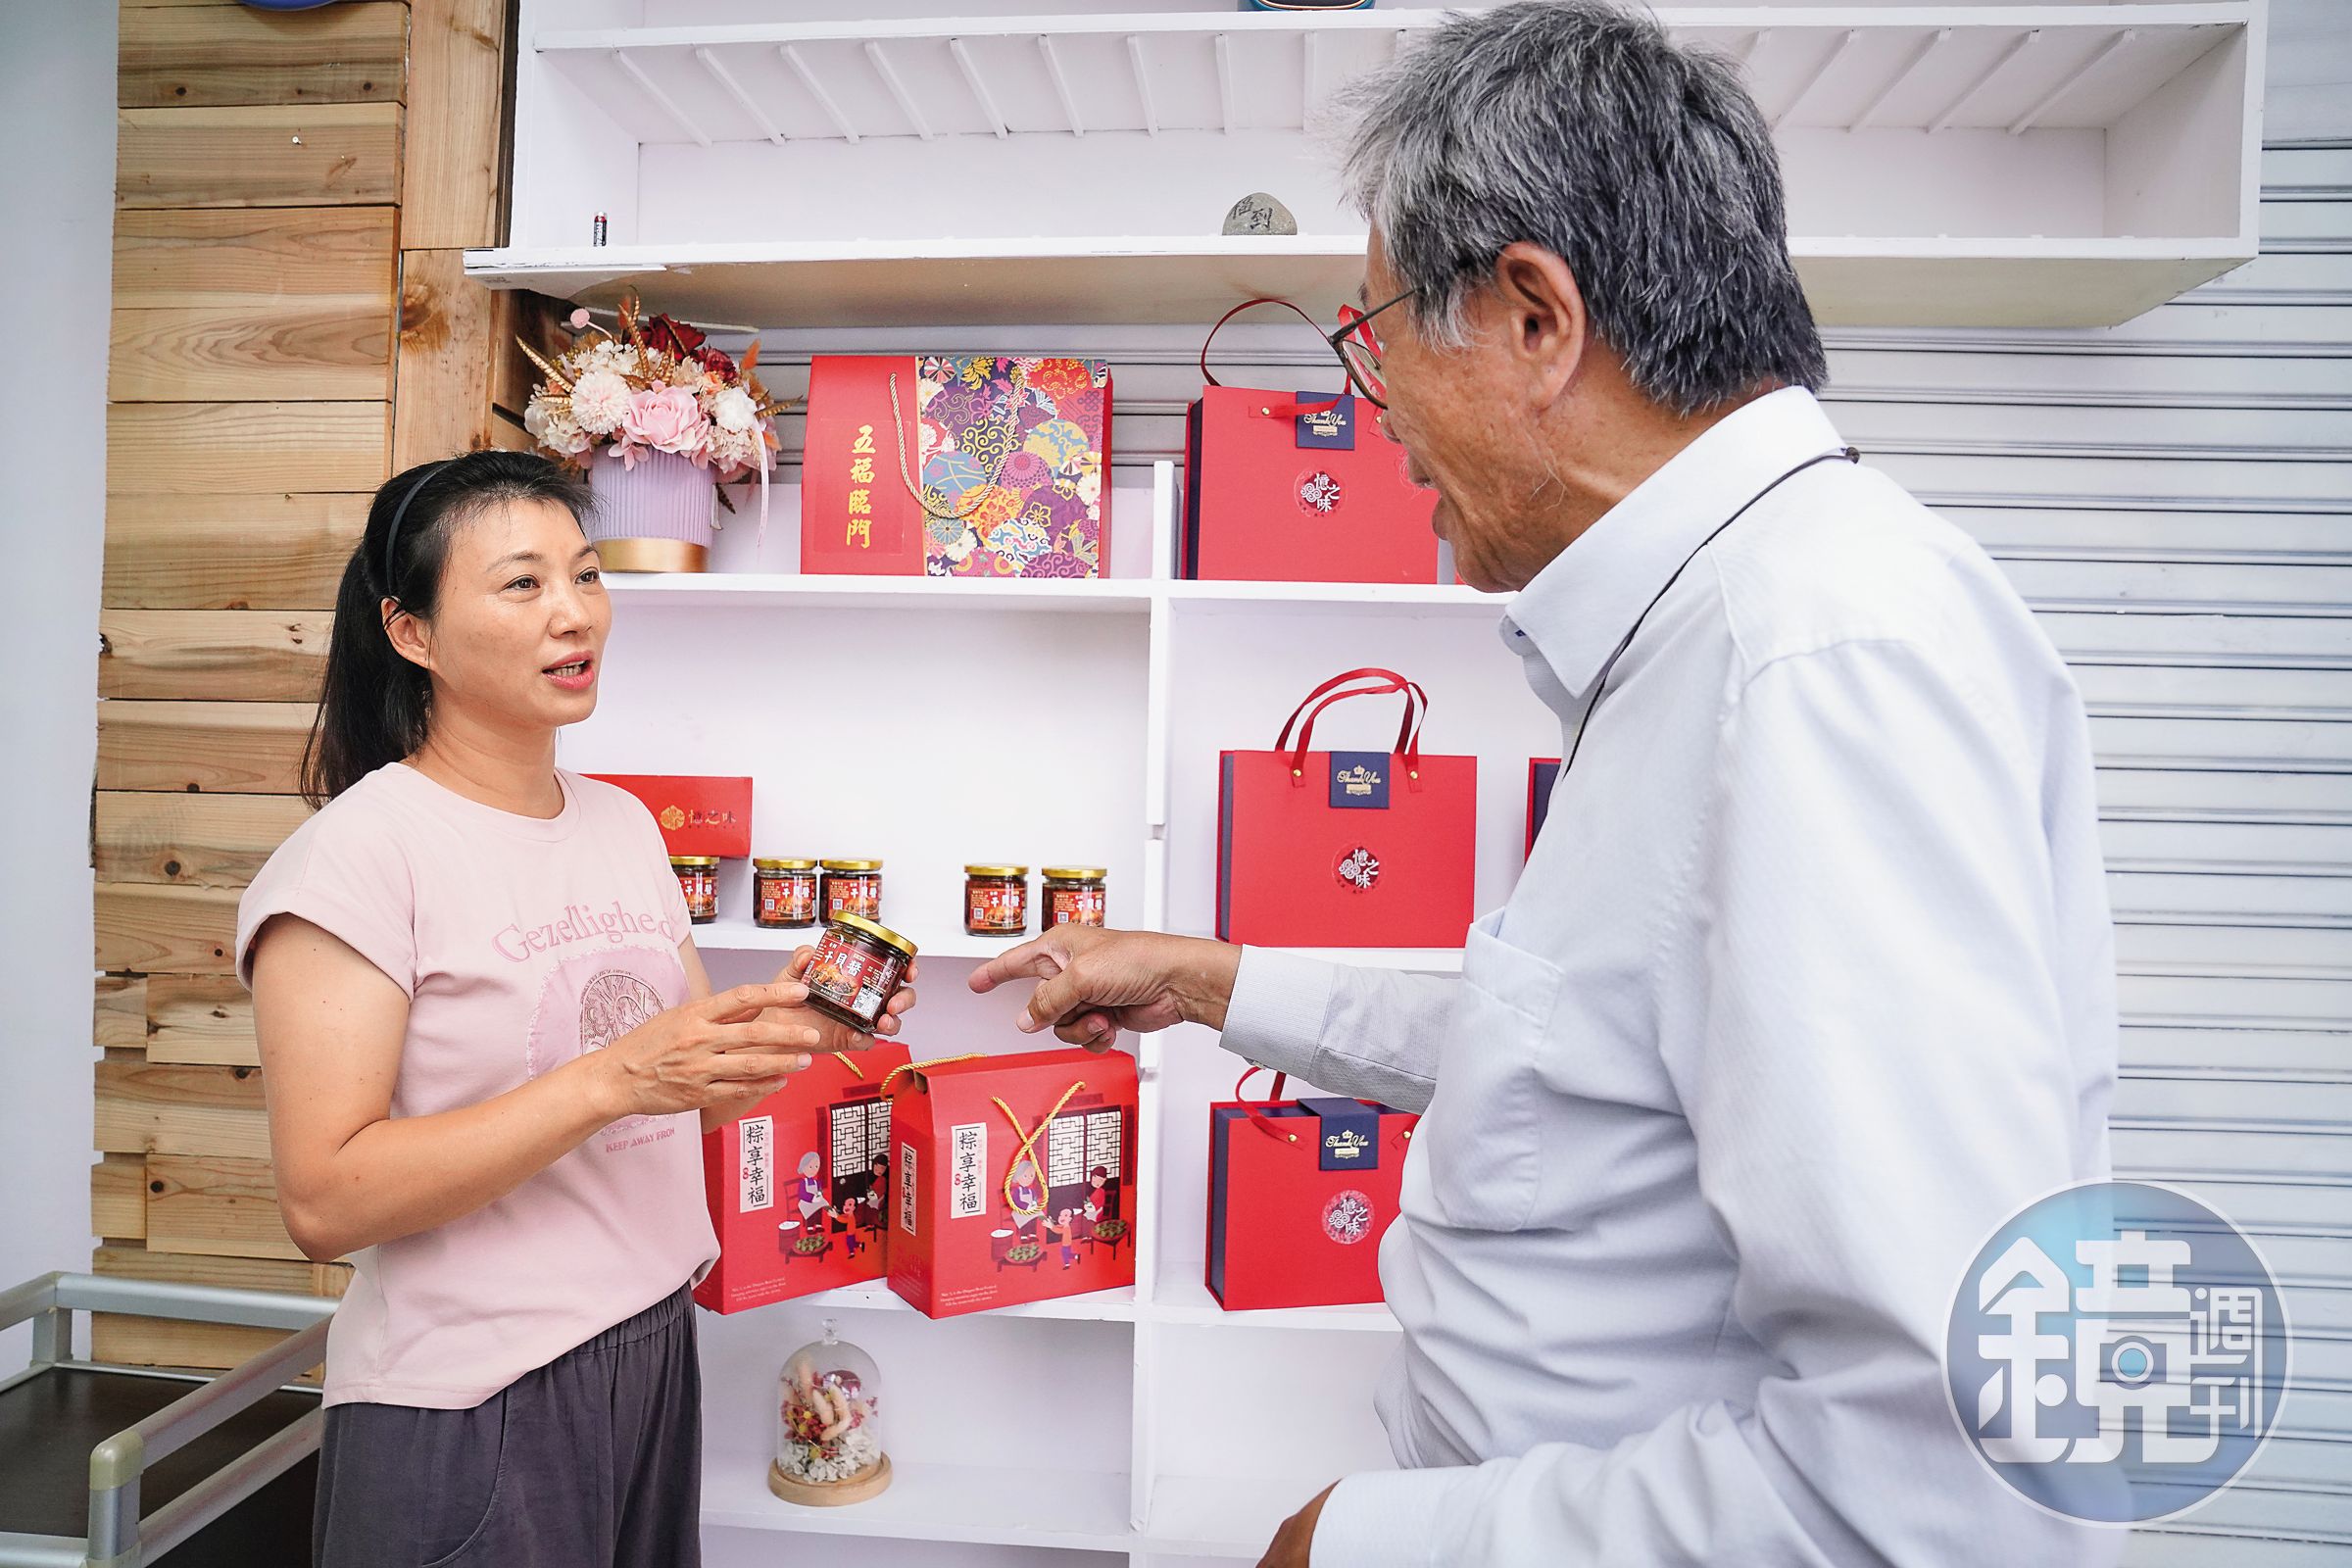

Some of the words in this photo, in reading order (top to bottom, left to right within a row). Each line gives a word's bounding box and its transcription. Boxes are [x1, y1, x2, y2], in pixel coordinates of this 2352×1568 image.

[846, 424, 876, 548] 五福臨門
[1314, 472, 1341, 513] 憶之味
[1337, 770, 1364, 784] Thank
[1363, 770, 1381, 784] You
[1352, 849, 1380, 889] 憶之味
[606, 1140, 629, 1152] KEEP
[630, 1133, 655, 1148] AWAY
[1325, 1136, 1352, 1148] Thank
[1351, 1135, 1369, 1148] You
[746, 1125, 765, 1204] 粽享幸福
[958, 1131, 978, 1211] 粽享幸福
[1341, 1199, 1368, 1236] 憶之味
